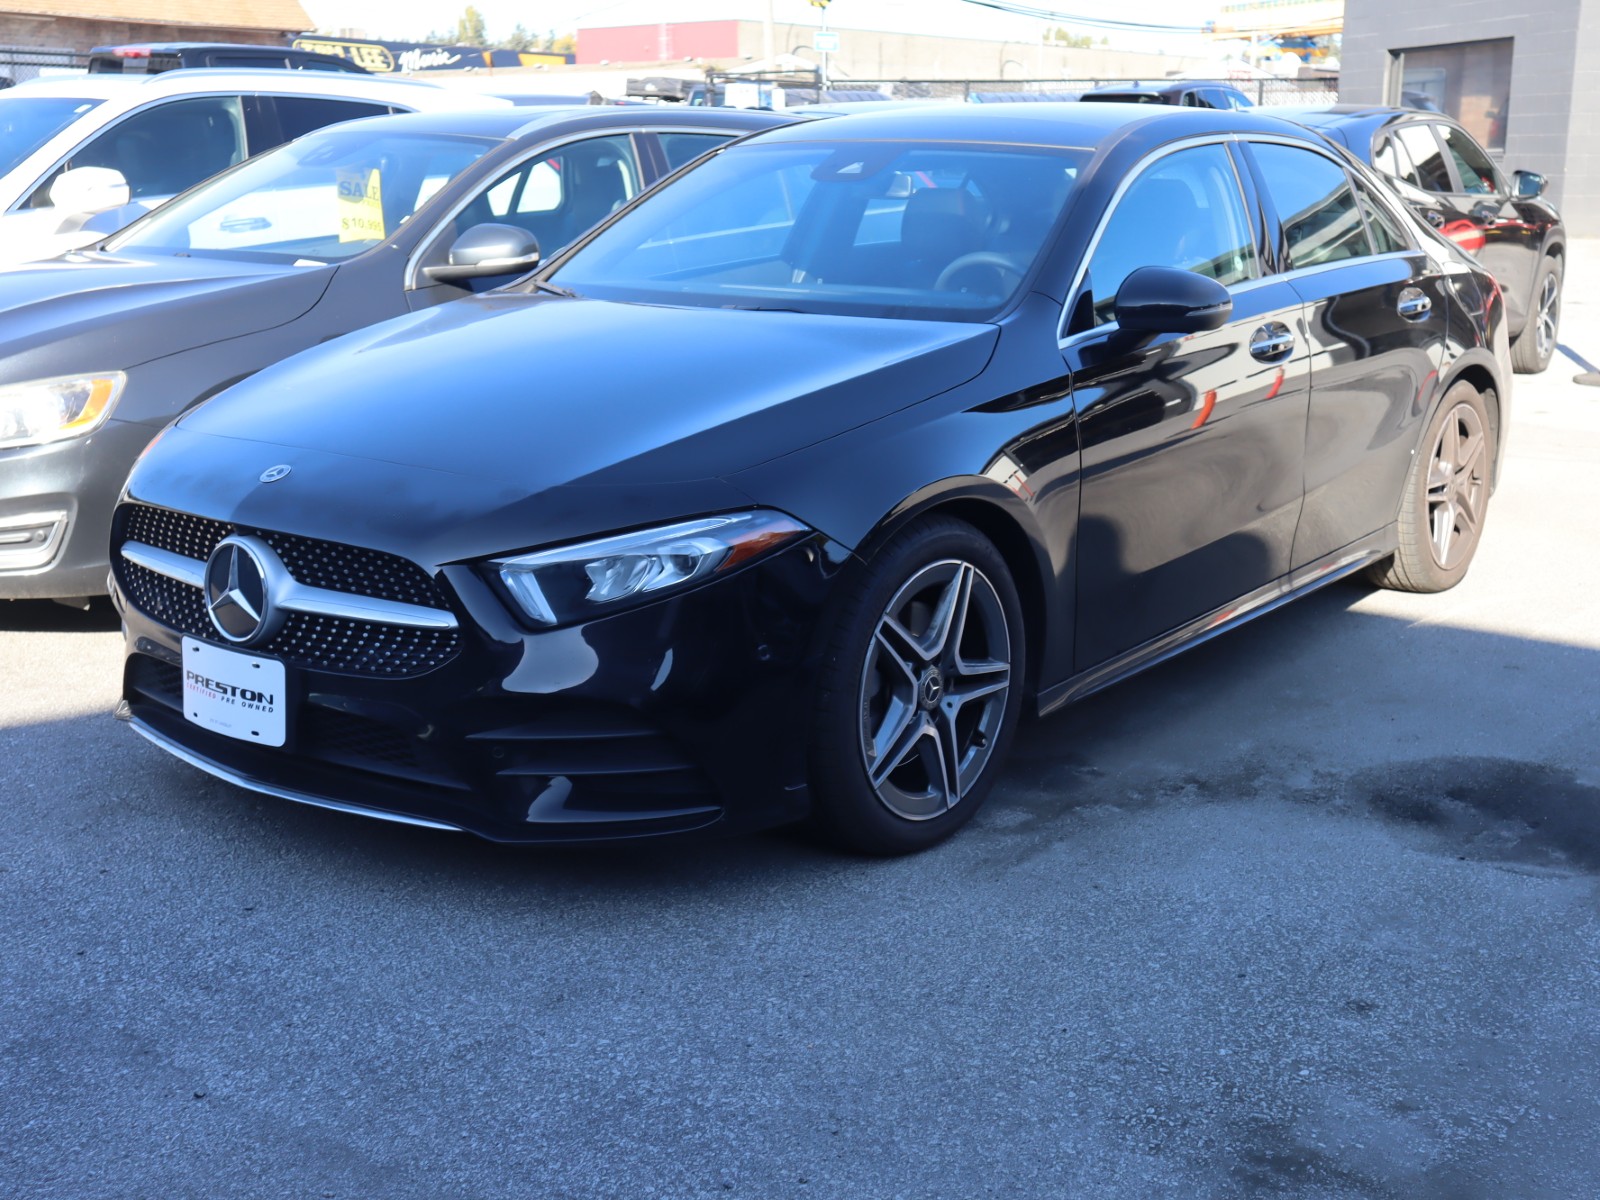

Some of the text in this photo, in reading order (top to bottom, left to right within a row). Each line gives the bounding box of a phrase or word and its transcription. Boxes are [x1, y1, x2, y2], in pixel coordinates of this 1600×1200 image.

[350, 46, 387, 68] LEE
[398, 48, 462, 73] Music
[339, 180, 380, 201] SALE
[186, 670, 274, 706] PRESTON
[186, 682, 274, 713] CERTIFIED PRE OWNED
